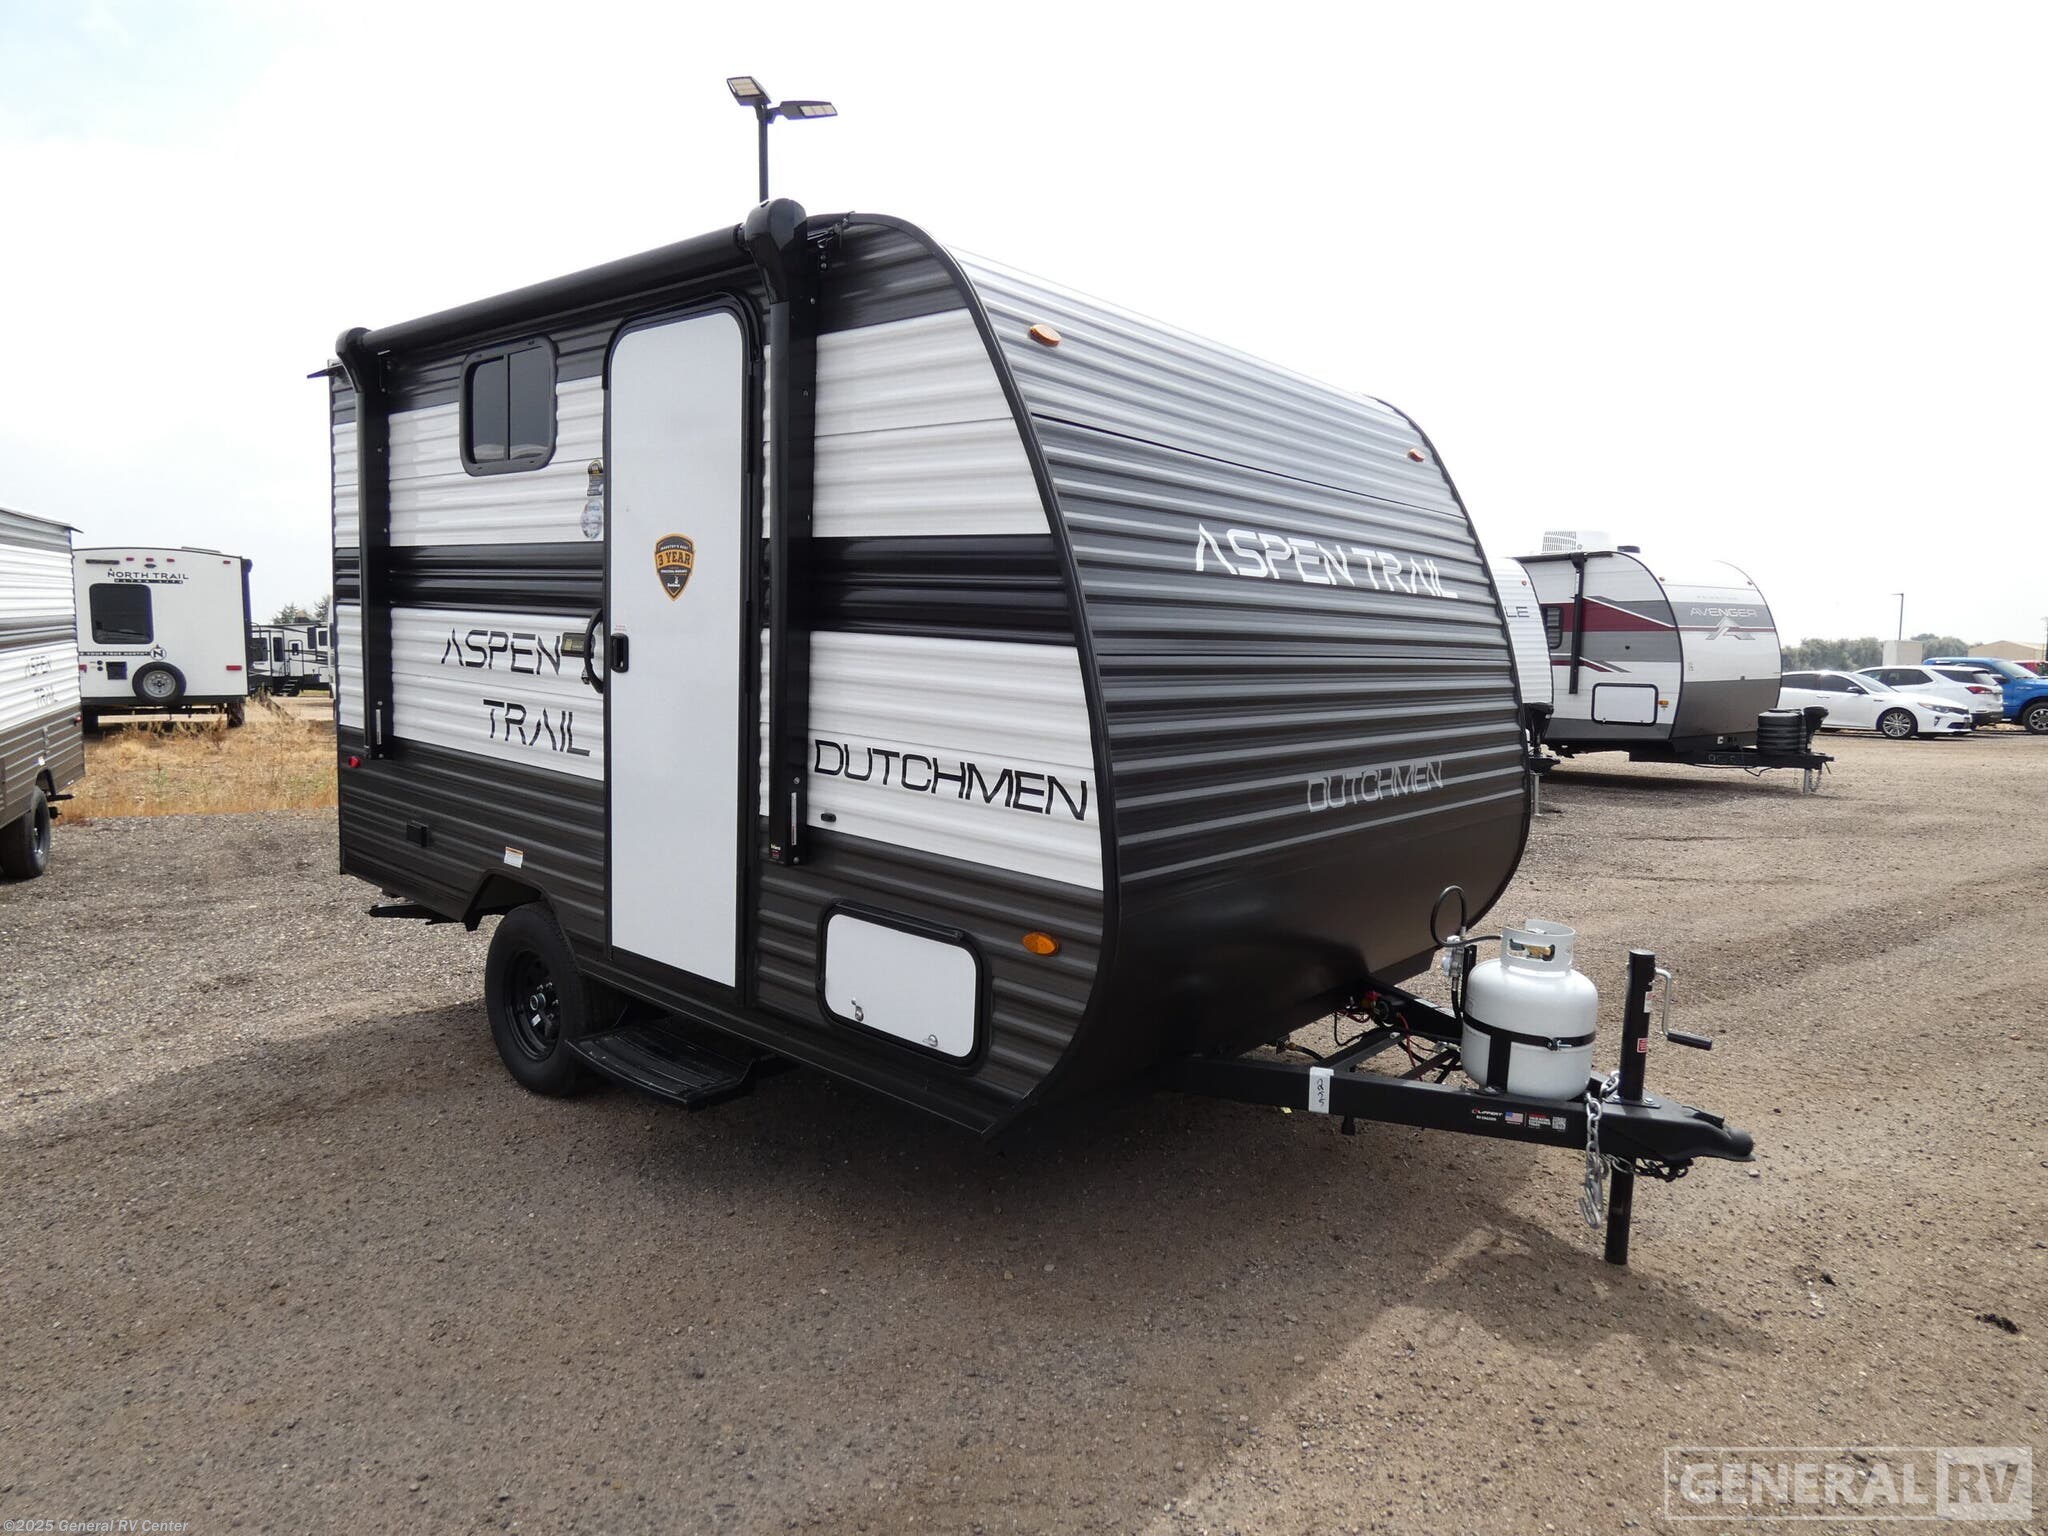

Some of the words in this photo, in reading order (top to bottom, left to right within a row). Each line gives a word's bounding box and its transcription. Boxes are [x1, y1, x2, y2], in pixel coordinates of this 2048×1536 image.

[107, 570, 149, 579] NORTH
[152, 572, 189, 580] TRAIL
[657, 554, 664, 566] 3
[665, 551, 691, 566] YEAR
[1196, 523, 1354, 586] ASPEN
[1351, 547, 1458, 599] TRAIL
[1690, 607, 1758, 617] AVENGER
[441, 628, 561, 676] ASPEN
[483, 698, 590, 757] TRAIL
[814, 739, 1088, 821] DUTCHMEN
[1307, 760, 1443, 813] DUTCHMEN
